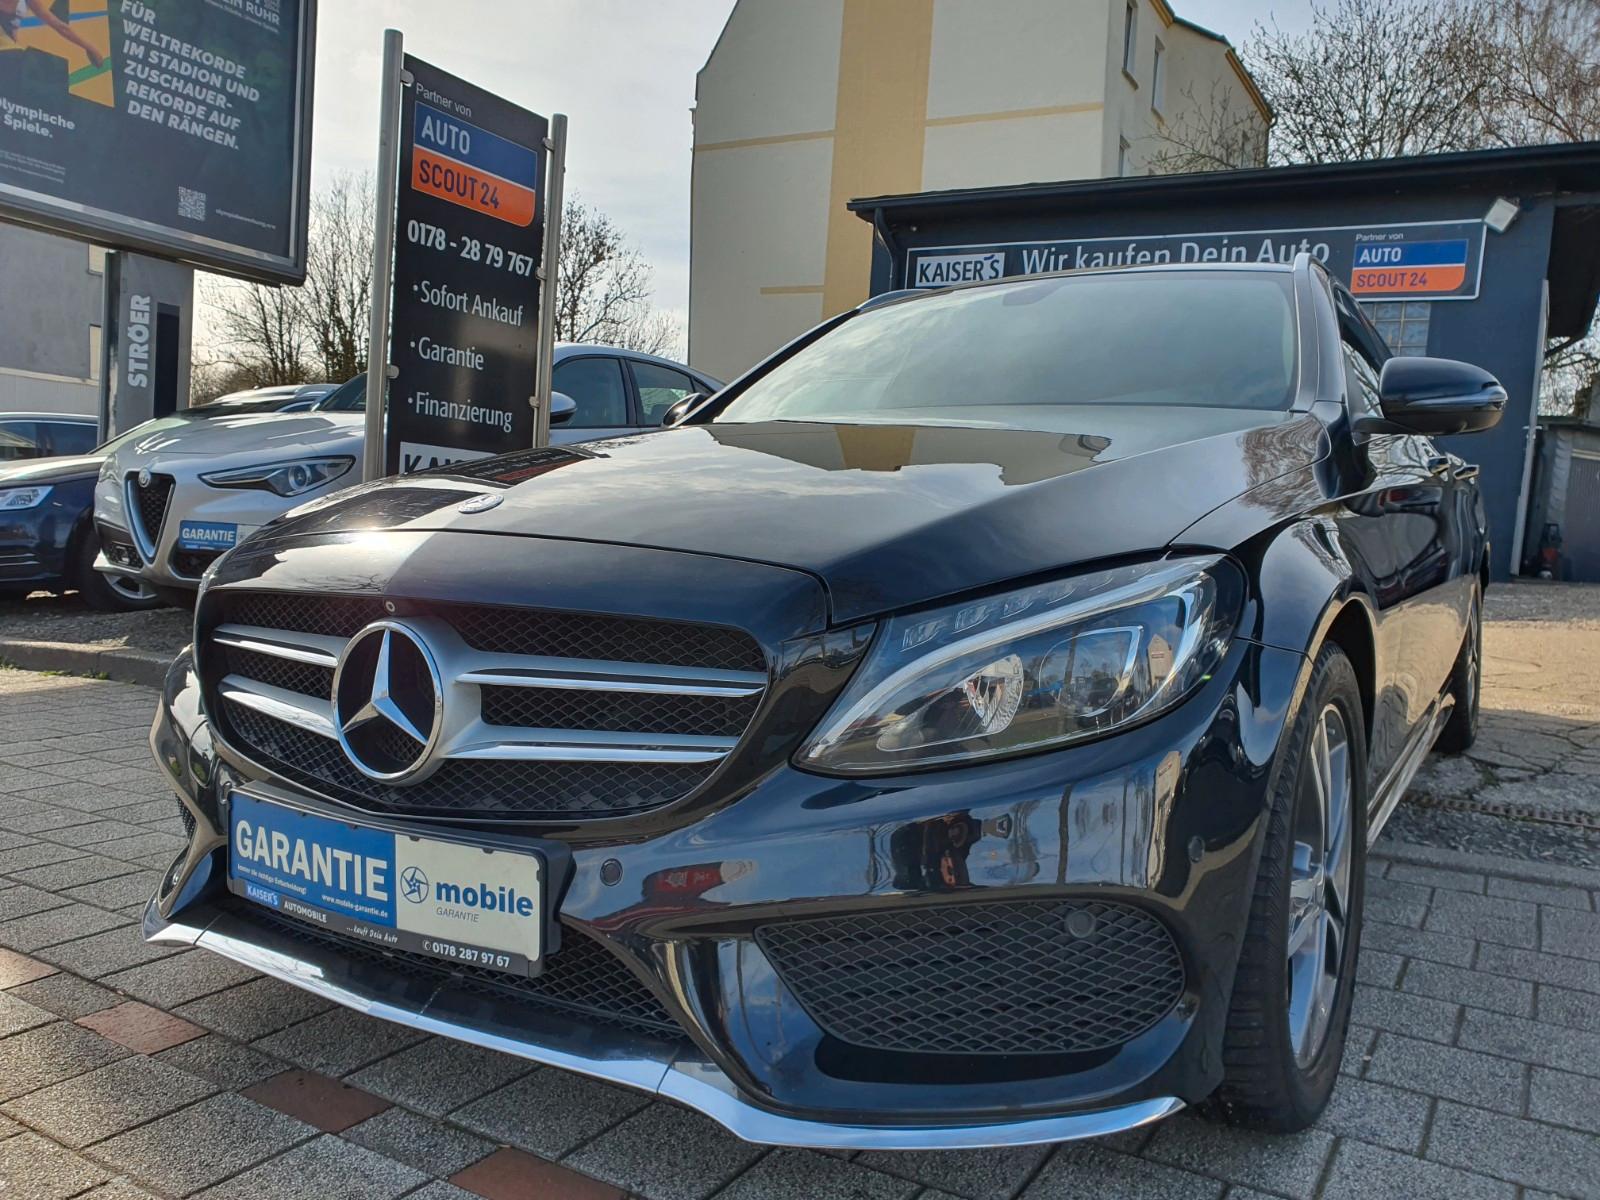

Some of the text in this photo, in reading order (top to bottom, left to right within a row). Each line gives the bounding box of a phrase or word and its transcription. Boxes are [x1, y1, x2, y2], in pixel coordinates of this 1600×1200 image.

[120, 0, 156, 25] FÜR
[246, 1, 280, 25] RUHR
[123, 19, 247, 80] WELTREKORDE
[123, 40, 260, 102] IM STADION UND
[124, 60, 233, 109] ZUSCHAUER-
[0, 97, 76, 130] lympische
[126, 80, 241, 130] REKORDE AUF
[416, 82, 472, 118] Partner von
[3, 113, 54, 138] Spiele.
[127, 100, 239, 150] DEN RÄNGEN.
[421, 115, 471, 155] AUTO
[407, 219, 446, 250] 0178
[460, 236, 481, 261] 28
[485, 243, 503, 268] 79
[507, 251, 533, 276] 767
[1355, 232, 1404, 241] Partner von
[1022, 246, 1068, 275] Wir
[1075, 243, 1170, 269] kaufen
[1180, 238, 1247, 263] Dein
[1256, 238, 1330, 264] Auto
[1359, 247, 1402, 263] AUTO
[420, 280, 523, 327] Sofort Ankauf
[127, 294, 151, 388] STRÖER
[418, 337, 485, 370] Garantie
[415, 391, 512, 433] Finanzierung
[182, 528, 236, 542] GARANTIE
[236, 820, 388, 902] GARANTIE
[284, 901, 327, 923] AUTOMOBILE
[436, 881, 533, 917] mobile
[436, 906, 480, 923] GARANTIE
[432, 942, 510, 968] 0178 287 97 67
